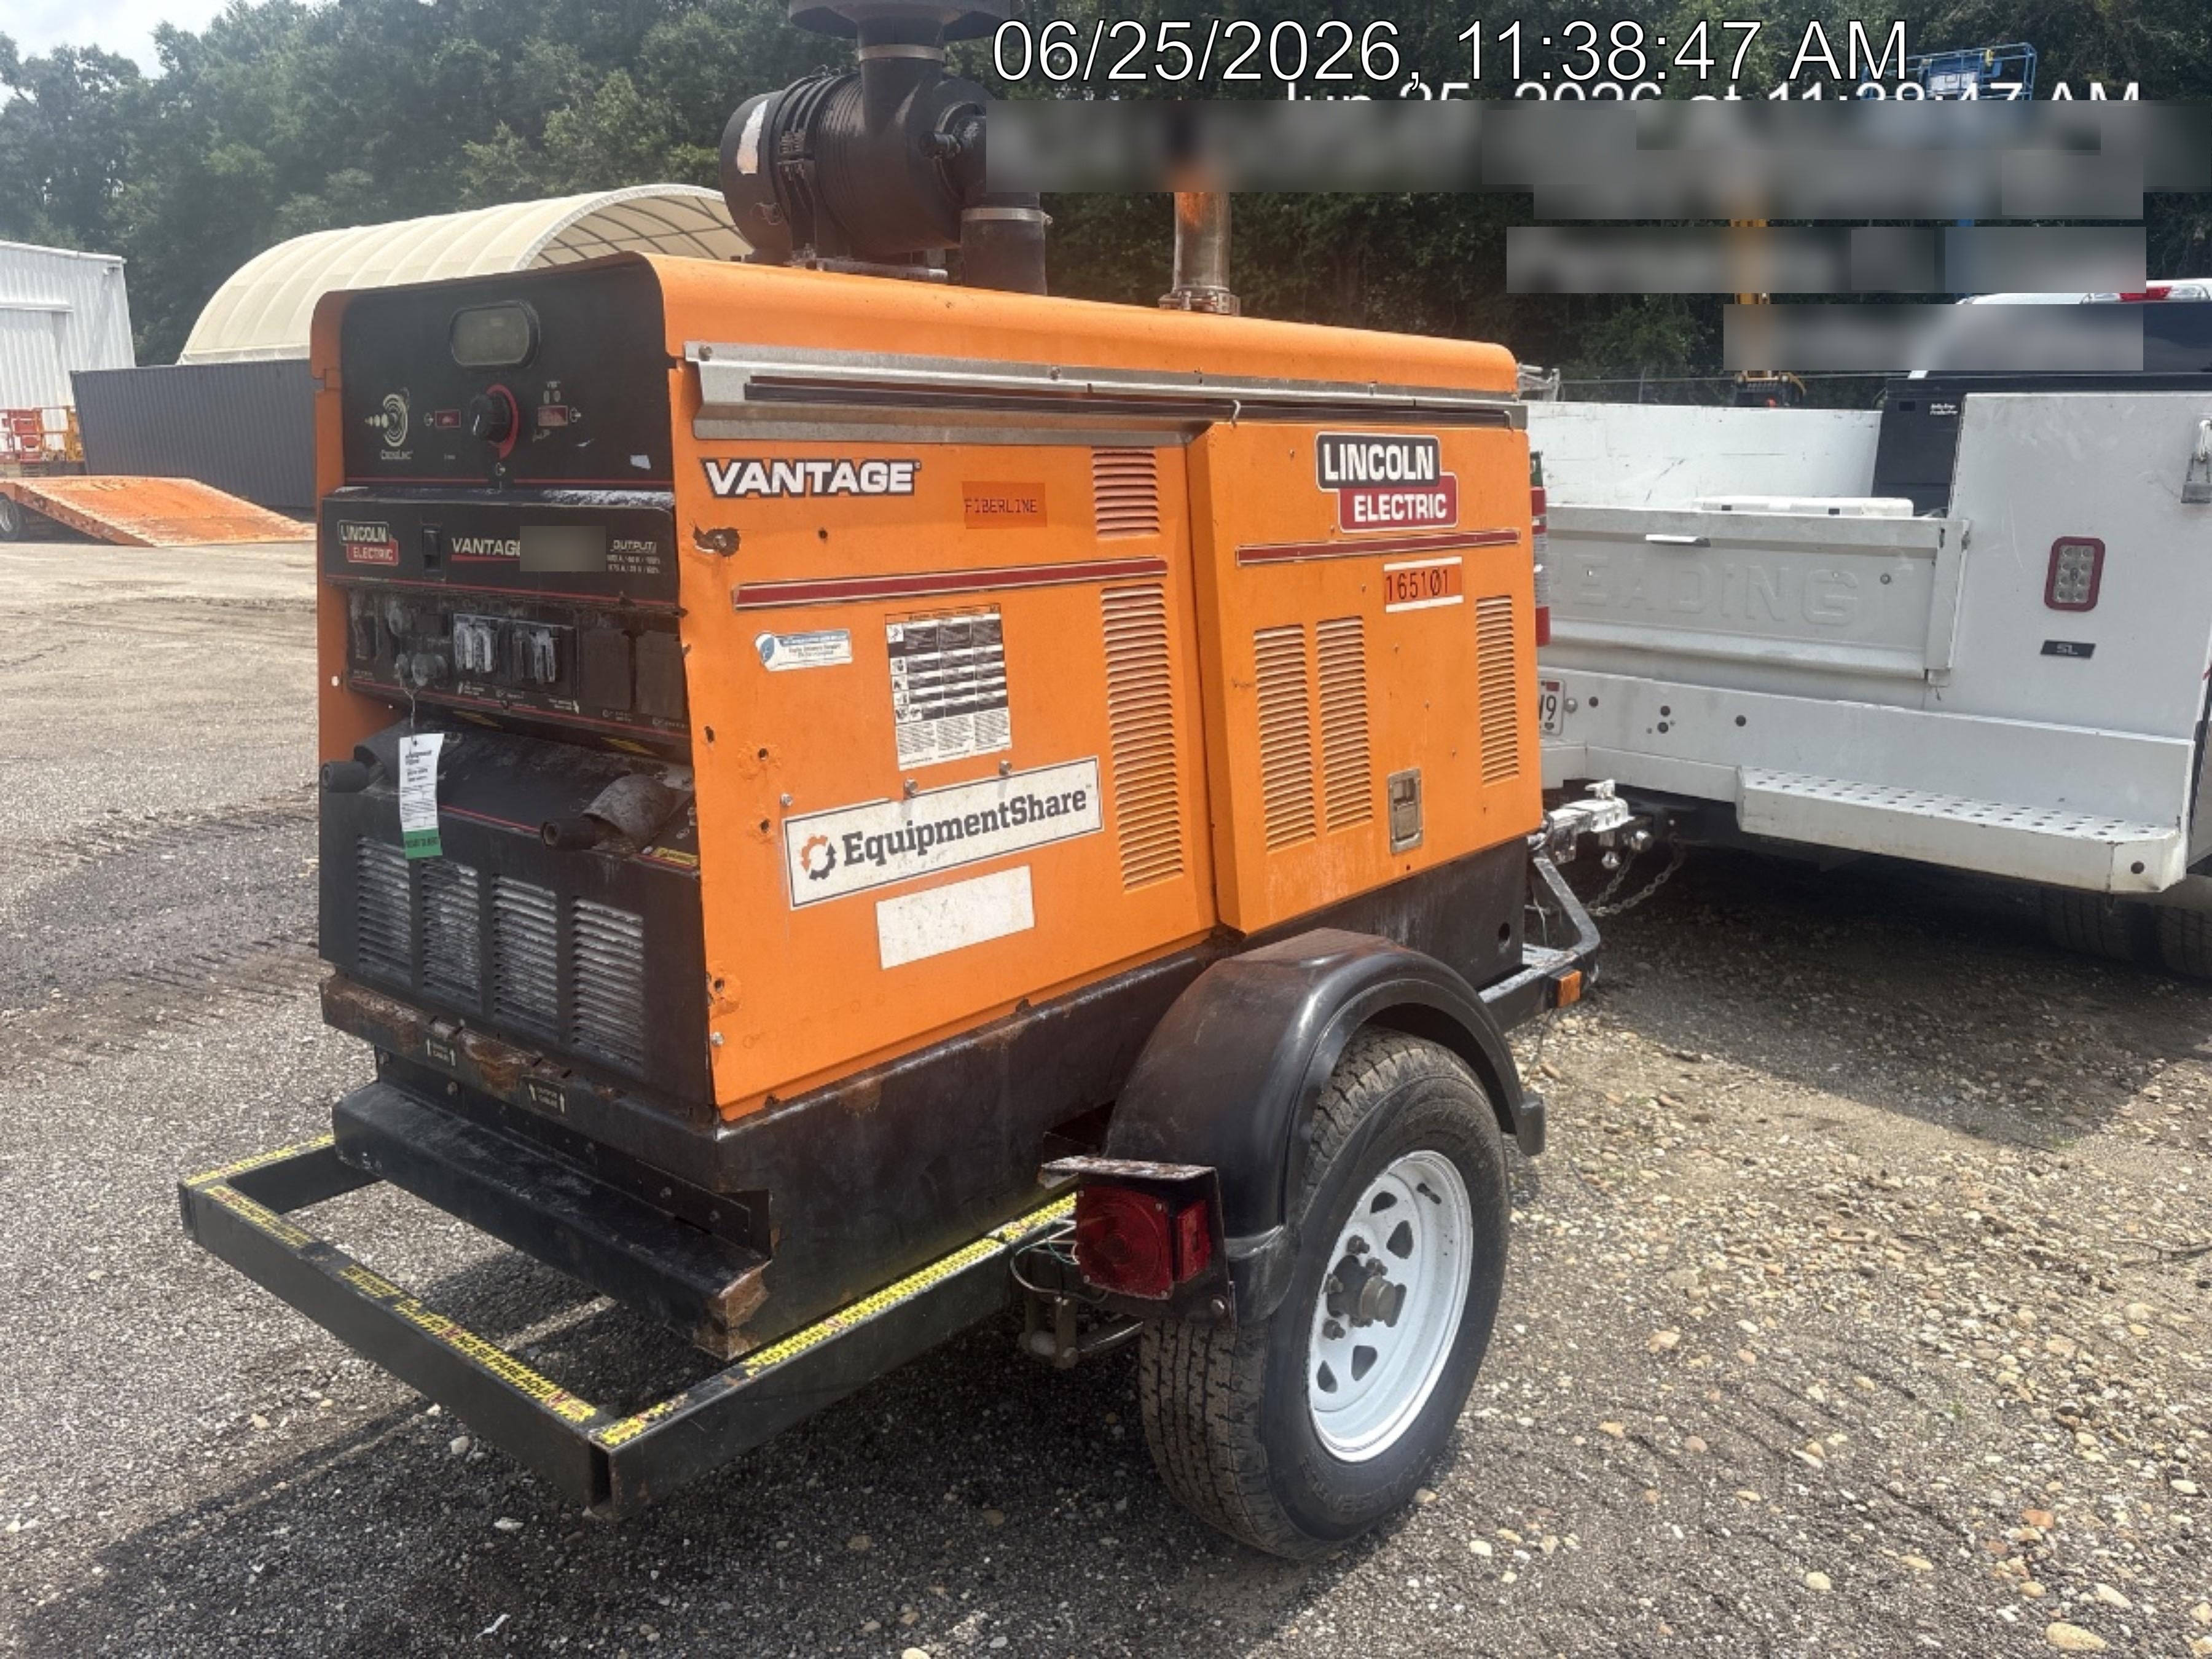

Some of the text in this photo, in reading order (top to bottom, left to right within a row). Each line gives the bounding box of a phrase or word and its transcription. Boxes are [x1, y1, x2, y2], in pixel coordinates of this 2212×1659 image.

[1322, 441, 1435, 482] LINCOLN
[702, 459, 920, 498] VANTAGE
[963, 498, 1038, 514] FIBERLINE
[1354, 493, 1448, 523] ELECTRIC
[340, 525, 387, 543] LINCOLN
[353, 546, 394, 560] ELECTRIC
[1385, 569, 1450, 601] 165101
[842, 790, 1086, 866] EquipmentShare
